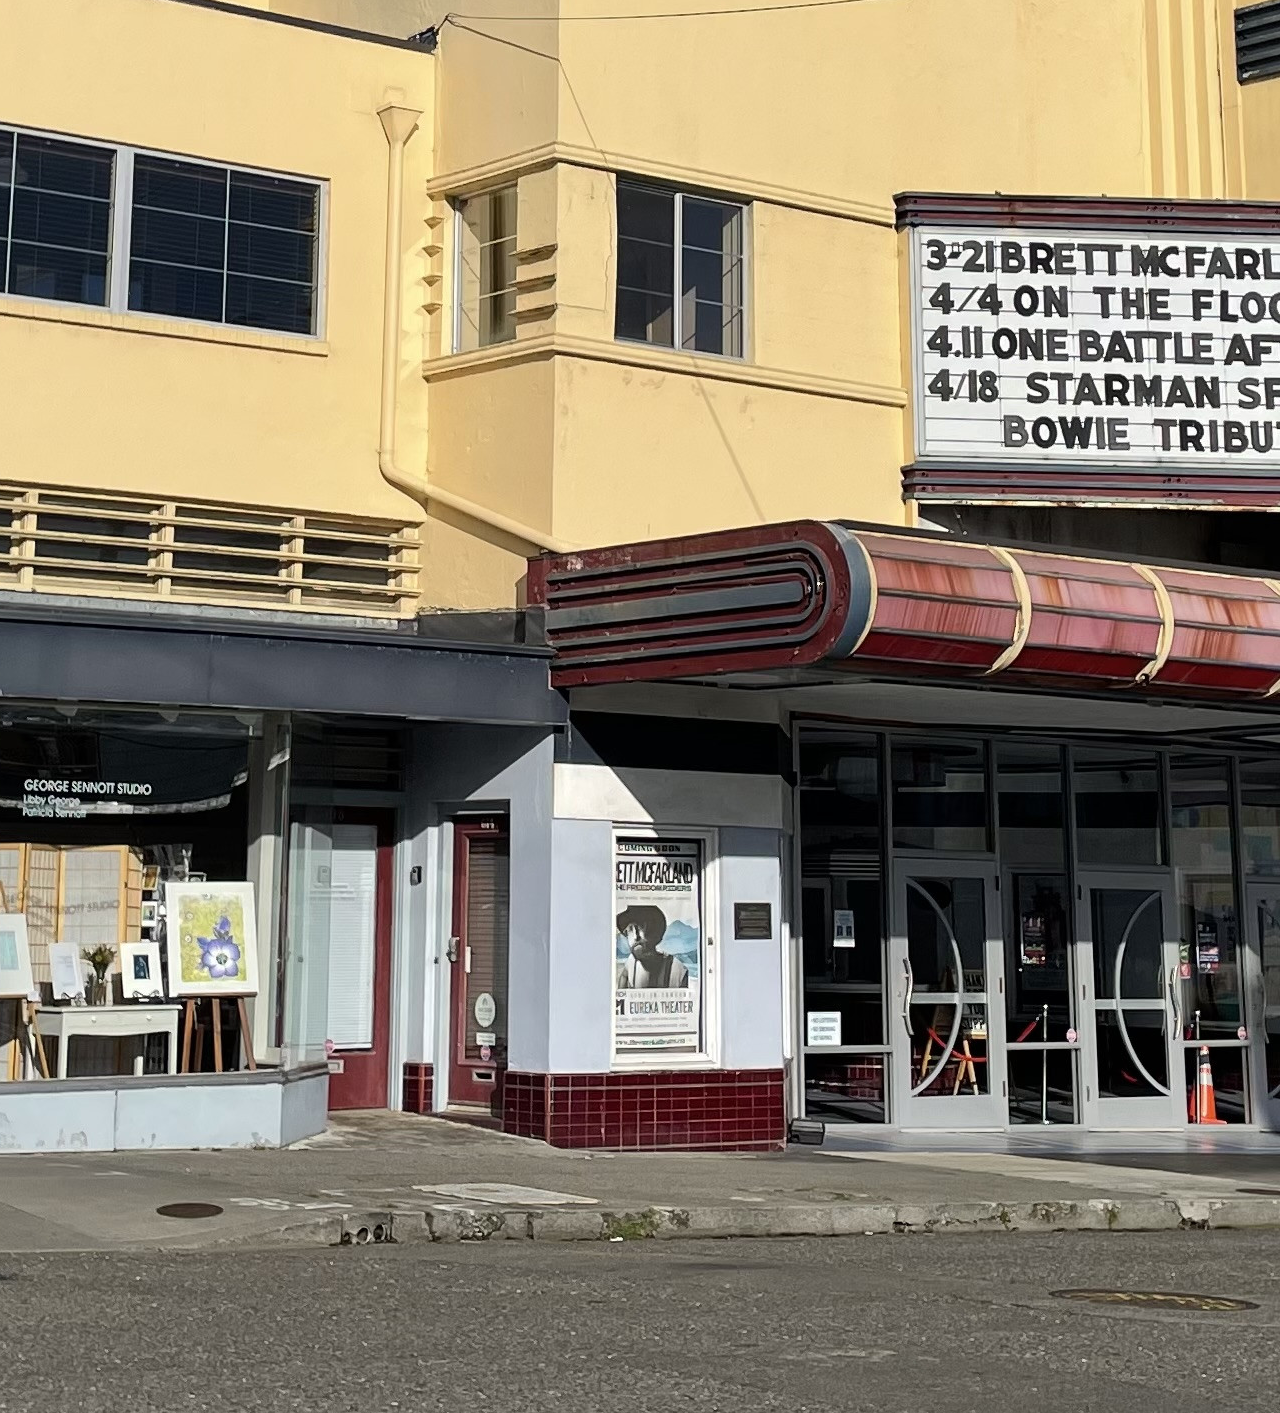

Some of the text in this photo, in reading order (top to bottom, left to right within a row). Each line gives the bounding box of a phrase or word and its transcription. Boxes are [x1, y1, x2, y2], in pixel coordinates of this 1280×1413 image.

[1001, 241, 1123, 276] BRETT
[928, 283, 1002, 315] 4/4
[1013, 285, 1068, 319] ON
[1093, 287, 1172, 321] THE
[927, 325, 983, 359] 4.11
[992, 327, 1069, 362] ONE
[1079, 330, 1215, 365] BATTLE
[928, 369, 999, 403] 4/18
[1026, 372, 1220, 409] STARMAN
[1003, 415, 1130, 451] BOWIE
[24, 779, 152, 795] GEORGE SENNOTT STUDIO
[629, 1001, 659, 1014] EUREKA
[661, 1000, 693, 1014] THEATER
